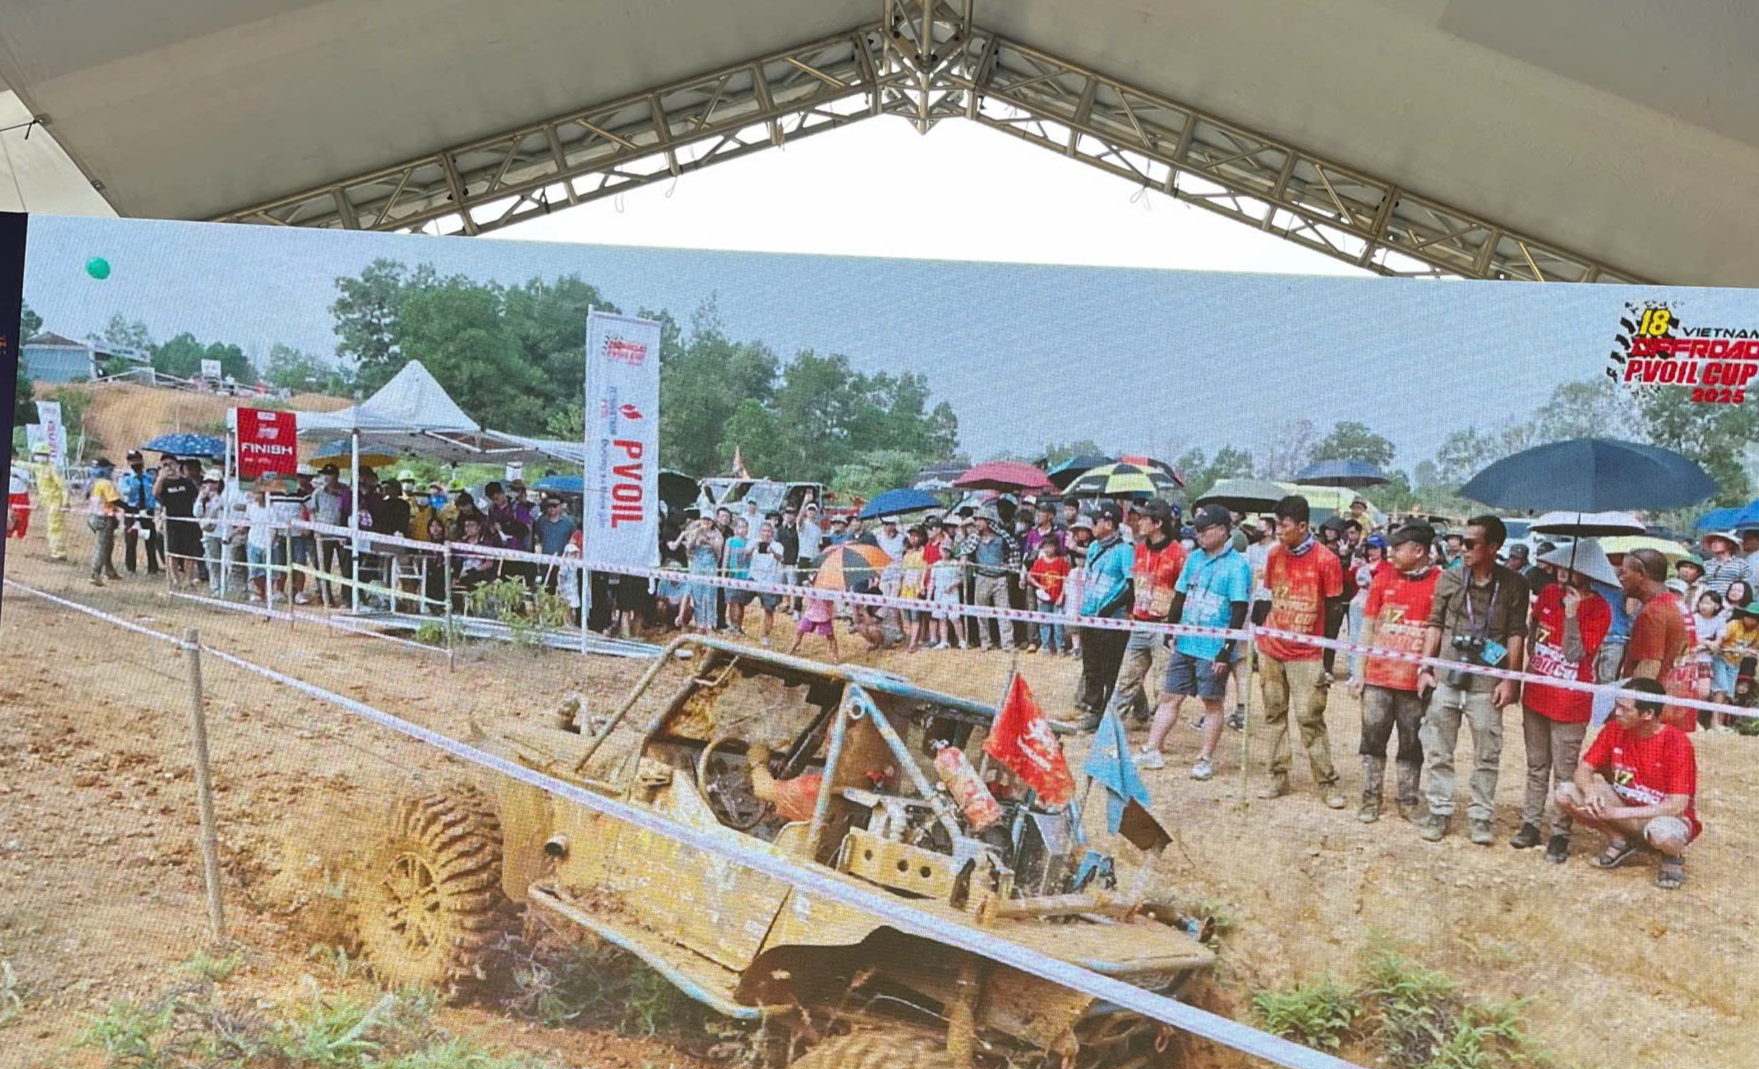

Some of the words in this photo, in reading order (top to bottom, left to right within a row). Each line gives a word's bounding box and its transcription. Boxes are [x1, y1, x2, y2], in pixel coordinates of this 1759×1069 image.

[1638, 308, 1671, 336] 18
[1624, 360, 1698, 385] PVOIL
[1702, 362, 1759, 386] CUP
[1691, 388, 1747, 404] 2025
[241, 442, 293, 455] FINISH
[611, 439, 644, 529] PVOIL
